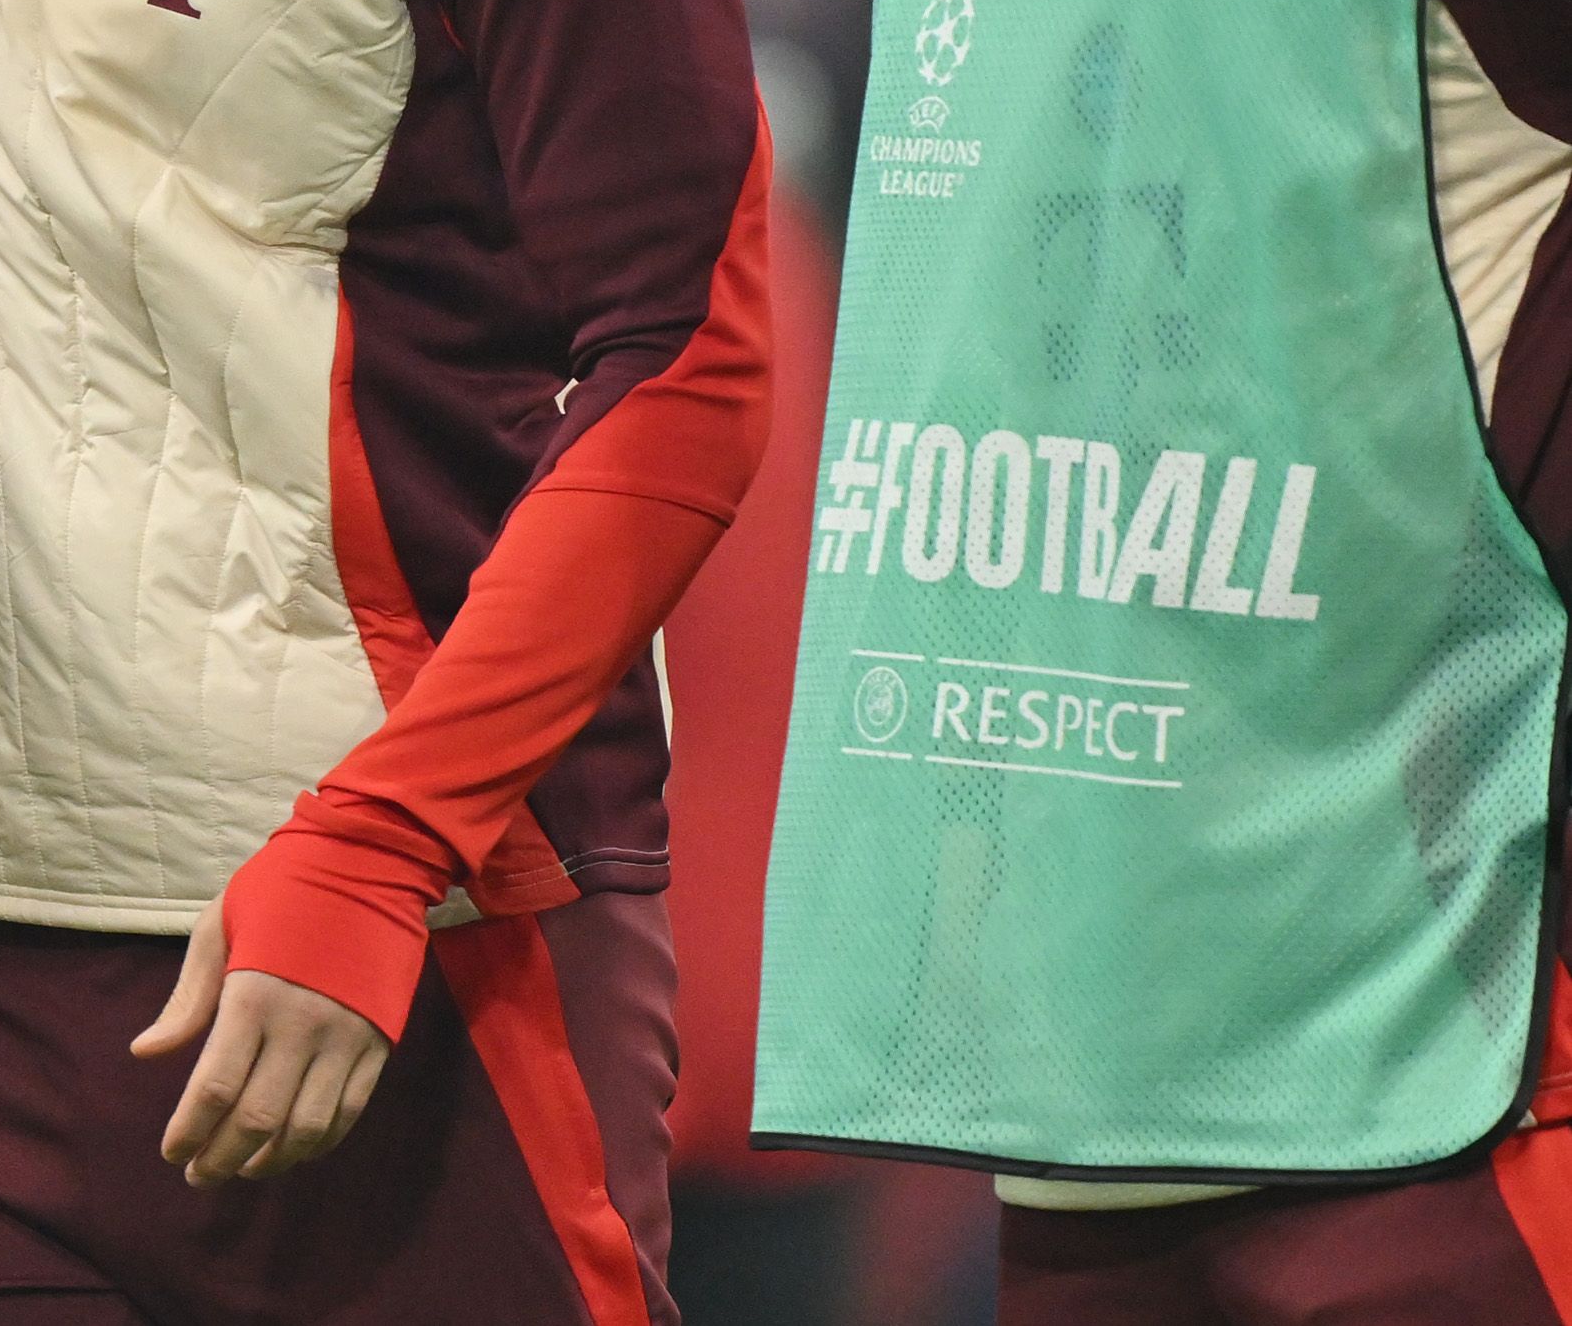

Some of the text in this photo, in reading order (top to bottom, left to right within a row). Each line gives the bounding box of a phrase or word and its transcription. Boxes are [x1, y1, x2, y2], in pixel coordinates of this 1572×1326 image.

[870, 135, 982, 167] CHAMPIONS
[815, 418, 1320, 621] #FOOTBALL
[931, 681, 1185, 763] RESPECT
